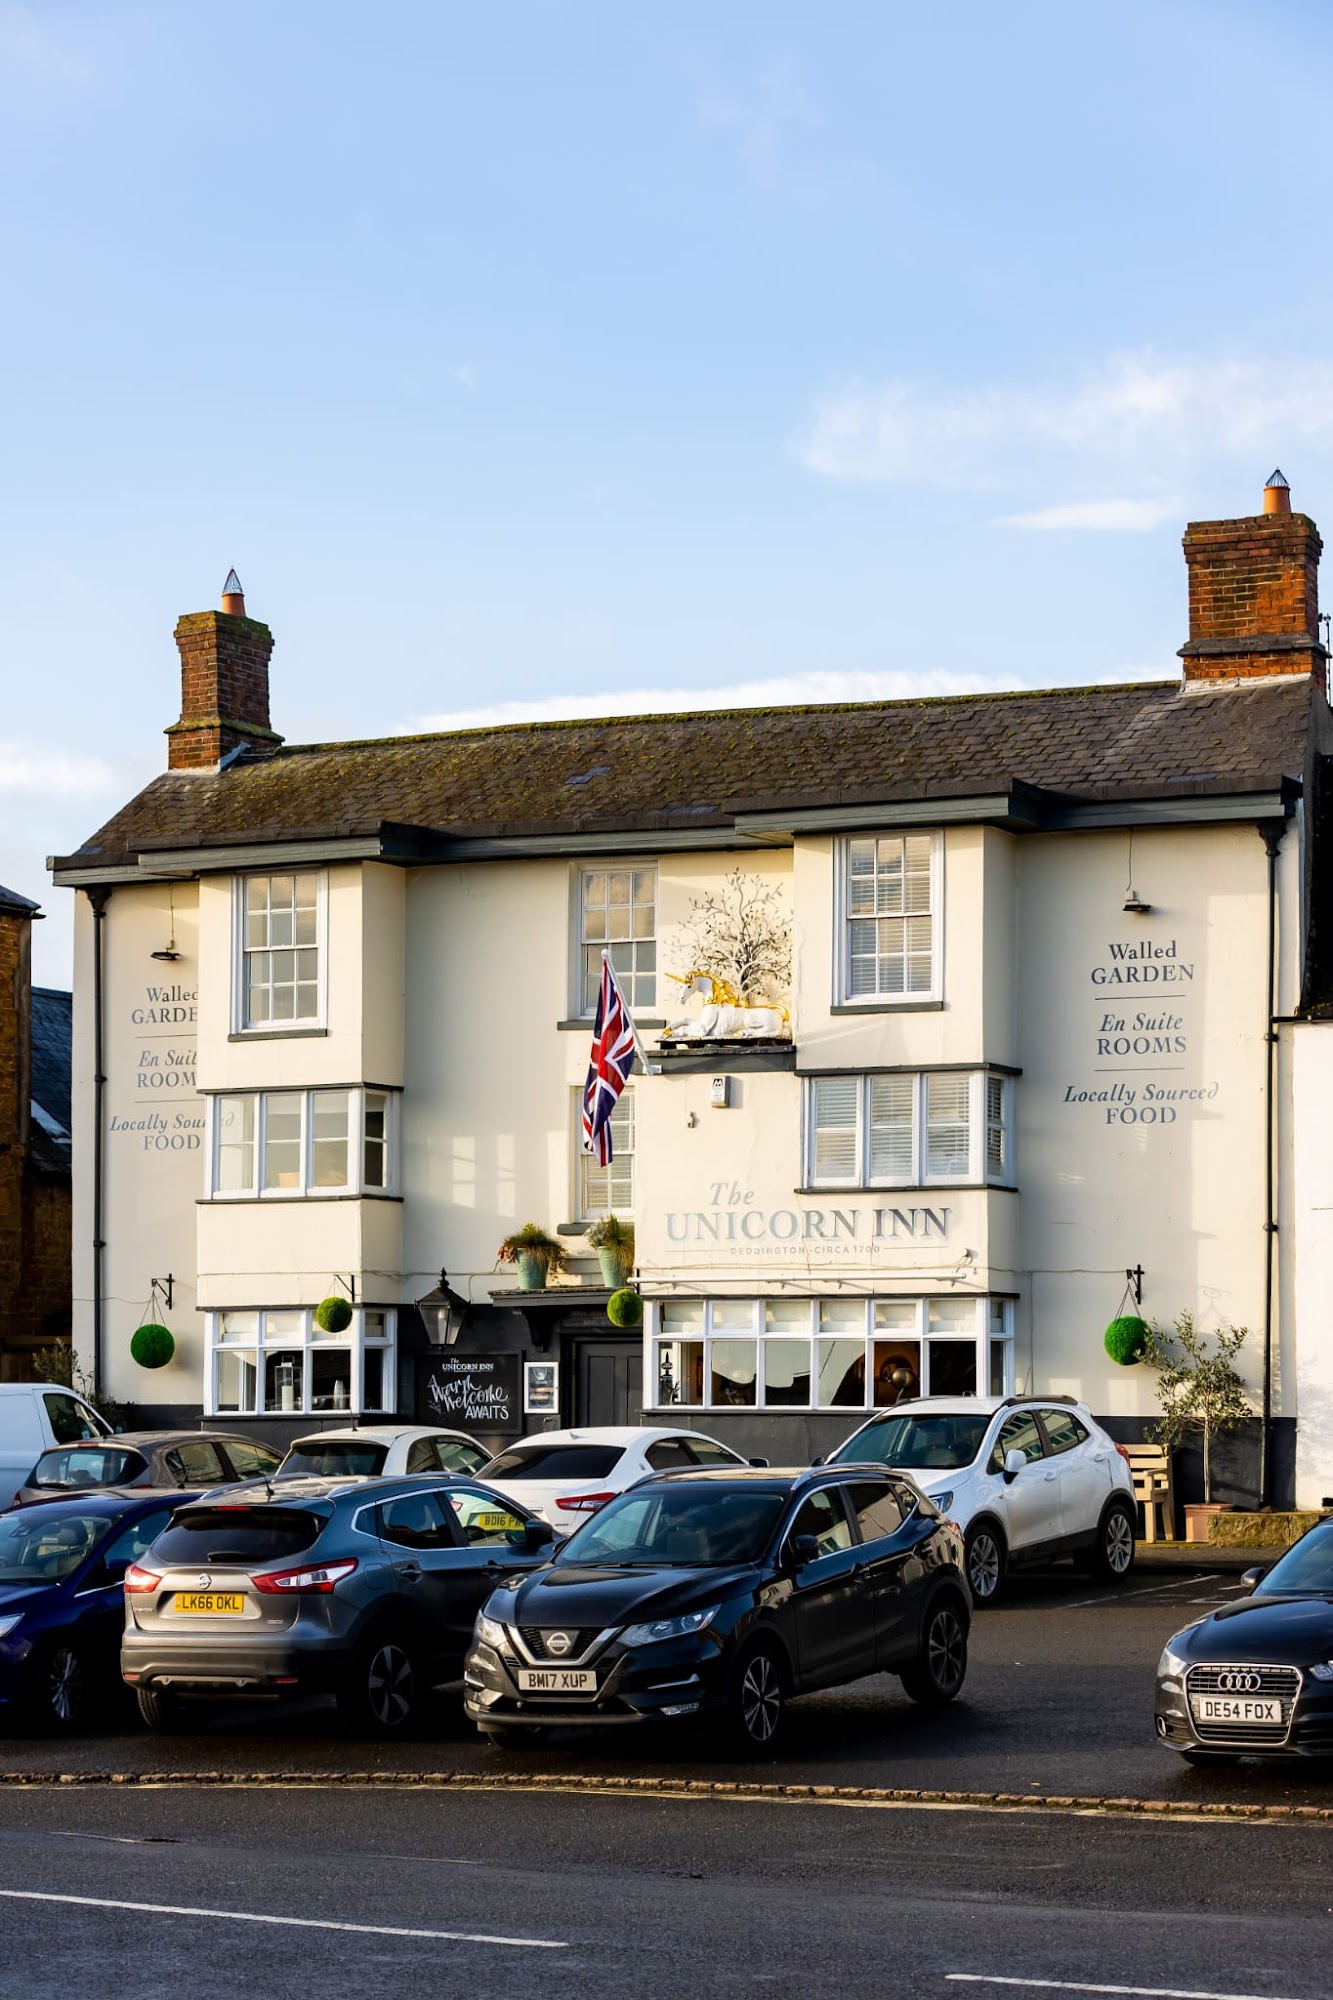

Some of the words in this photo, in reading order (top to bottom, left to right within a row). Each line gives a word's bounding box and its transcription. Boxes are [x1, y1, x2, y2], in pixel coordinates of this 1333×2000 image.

[1109, 940, 1176, 960] Walled
[1091, 964, 1195, 984] GARDEN
[132, 1007, 198, 1024] GARDE
[1099, 1014, 1125, 1032] En
[1133, 1012, 1183, 1031] Suite
[1097, 1036, 1187, 1055] ROOMS
[139, 1051, 158, 1067] En
[165, 1050, 197, 1066] Suit
[137, 1072, 197, 1088] ROOM
[1063, 1083, 1136, 1105] Locally
[1143, 1081, 1219, 1101] Sourced
[110, 1114, 168, 1134] Locally
[1106, 1107, 1176, 1125] FOOD
[144, 1135, 201, 1150] FOOD
[710, 1181, 754, 1206] The
[664, 1209, 860, 1241] UNICORN
[872, 1207, 951, 1238] INN
[730, 1246, 805, 1256] DEDDINGTON
[853, 1245, 880, 1254] 1700
[442, 1363, 478, 1371] UNICORN
[479, 1363, 494, 1371] INN
[465, 1405, 509, 1420] AWAITS
[485, 1515, 506, 1526] BD16
[182, 1595, 214, 1610] LK66
[216, 1596, 240, 1610] OKL
[528, 1673, 557, 1688] BM17
[561, 1673, 588, 1688] XUP
[1205, 1701, 1240, 1718] DE54
[1244, 1703, 1274, 1719] FOX
